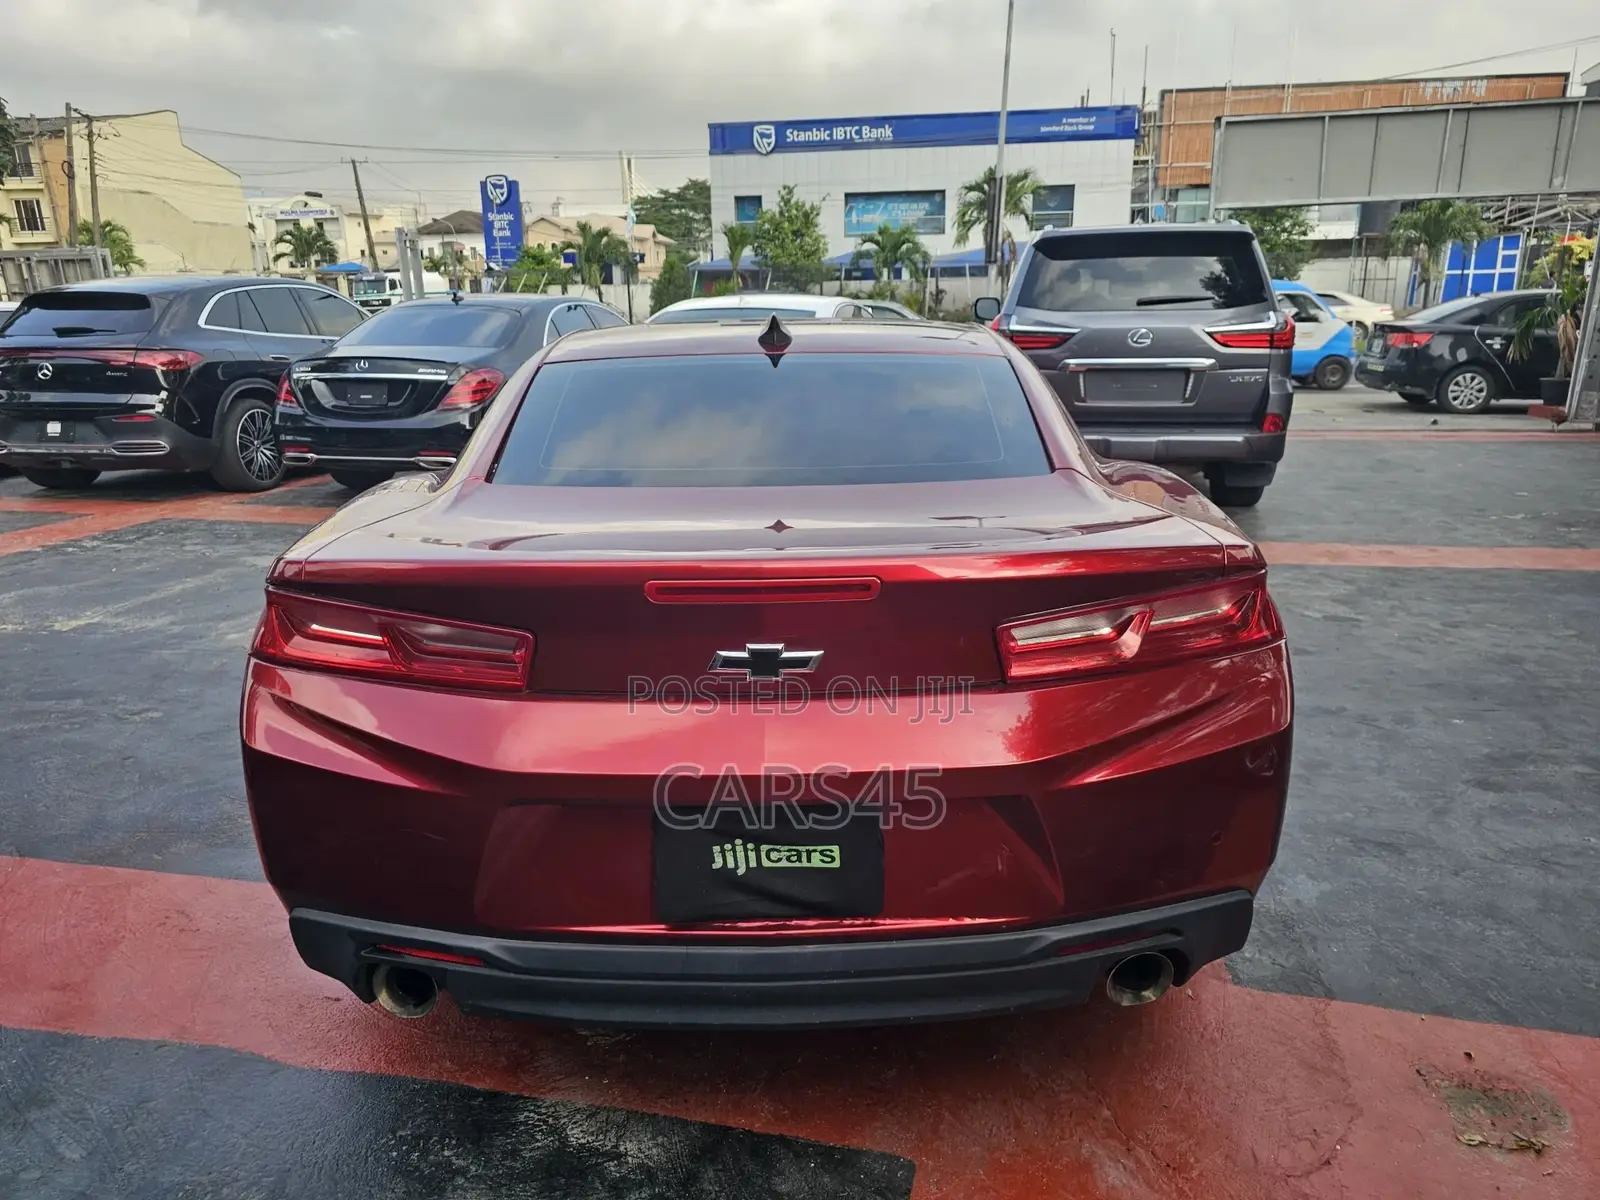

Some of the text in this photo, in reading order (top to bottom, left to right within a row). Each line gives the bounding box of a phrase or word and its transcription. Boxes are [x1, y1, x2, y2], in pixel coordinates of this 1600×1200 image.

[786, 124, 894, 142] Stanbic IBTC Bank
[487, 212, 515, 221] Stanbic
[764, 846, 837, 865] cars
